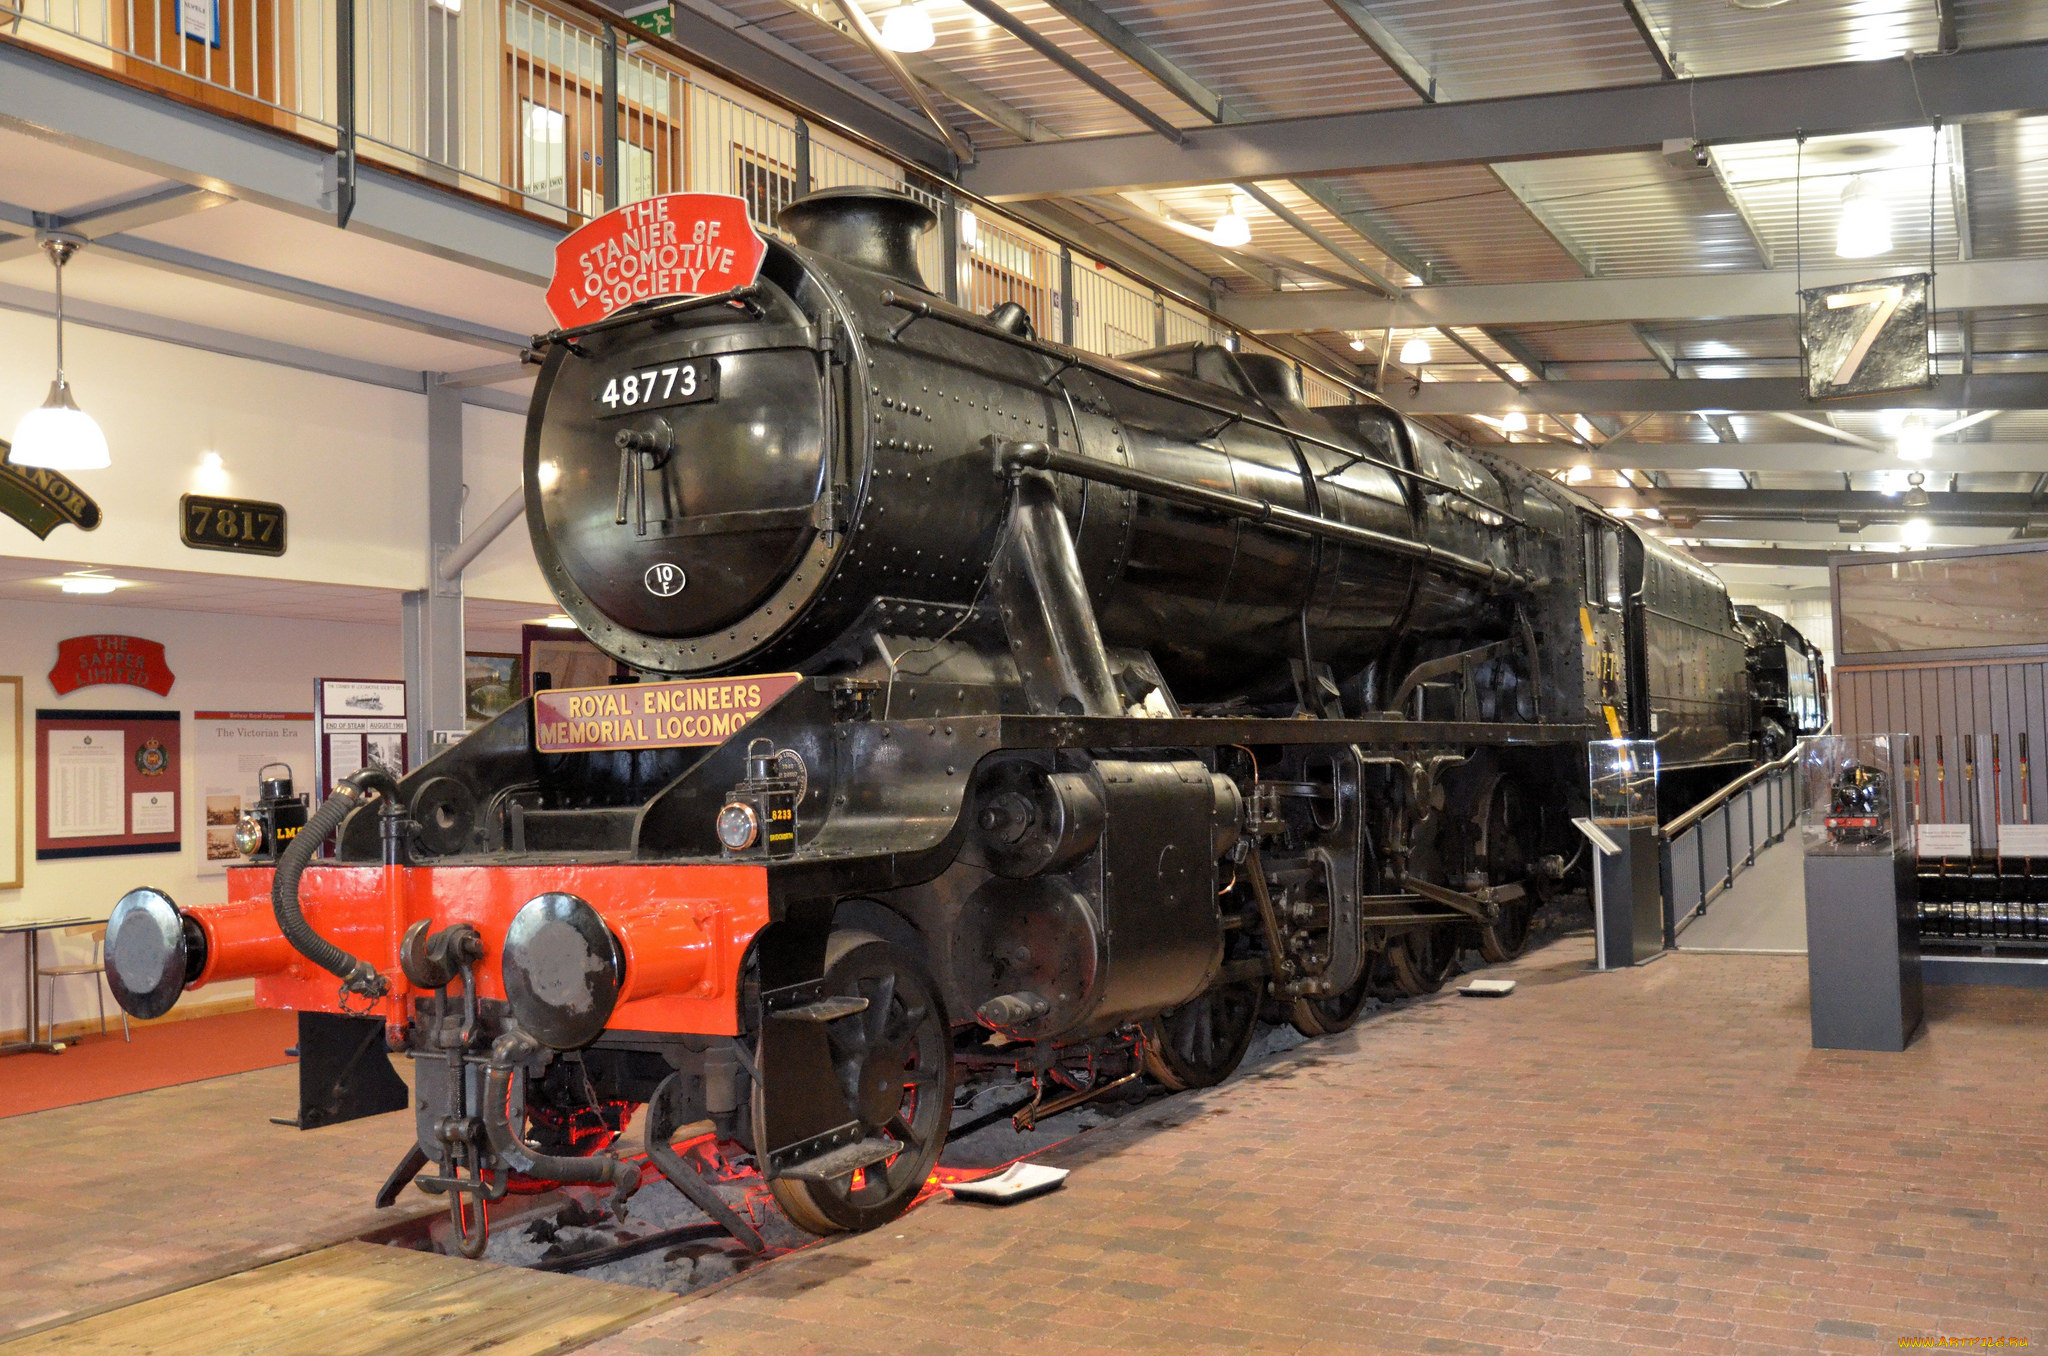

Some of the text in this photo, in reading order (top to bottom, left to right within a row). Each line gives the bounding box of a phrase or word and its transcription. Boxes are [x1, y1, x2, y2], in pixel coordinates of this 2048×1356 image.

[620, 198, 668, 230] THE
[579, 220, 721, 277] STANIER 8F
[570, 244, 735, 310] LOCOMOTIVE
[600, 268, 705, 313] SOCIETY
[1827, 286, 1903, 385] 7
[602, 365, 696, 409] 48773
[0, 446, 83, 518] NOR
[191, 505, 280, 542] 7817
[656, 566, 673, 583] 10
[662, 581, 670, 595] F
[94, 637, 129, 651] THE
[79, 652, 145, 669] SAPPER
[75, 668, 149, 686] LIMITED
[569, 685, 761, 719] ROYAL ENGINEERS
[216, 728, 298, 737] The Victorian Era
[540, 718, 649, 745] MEMORIAL
[772, 809, 792, 821] 8233
